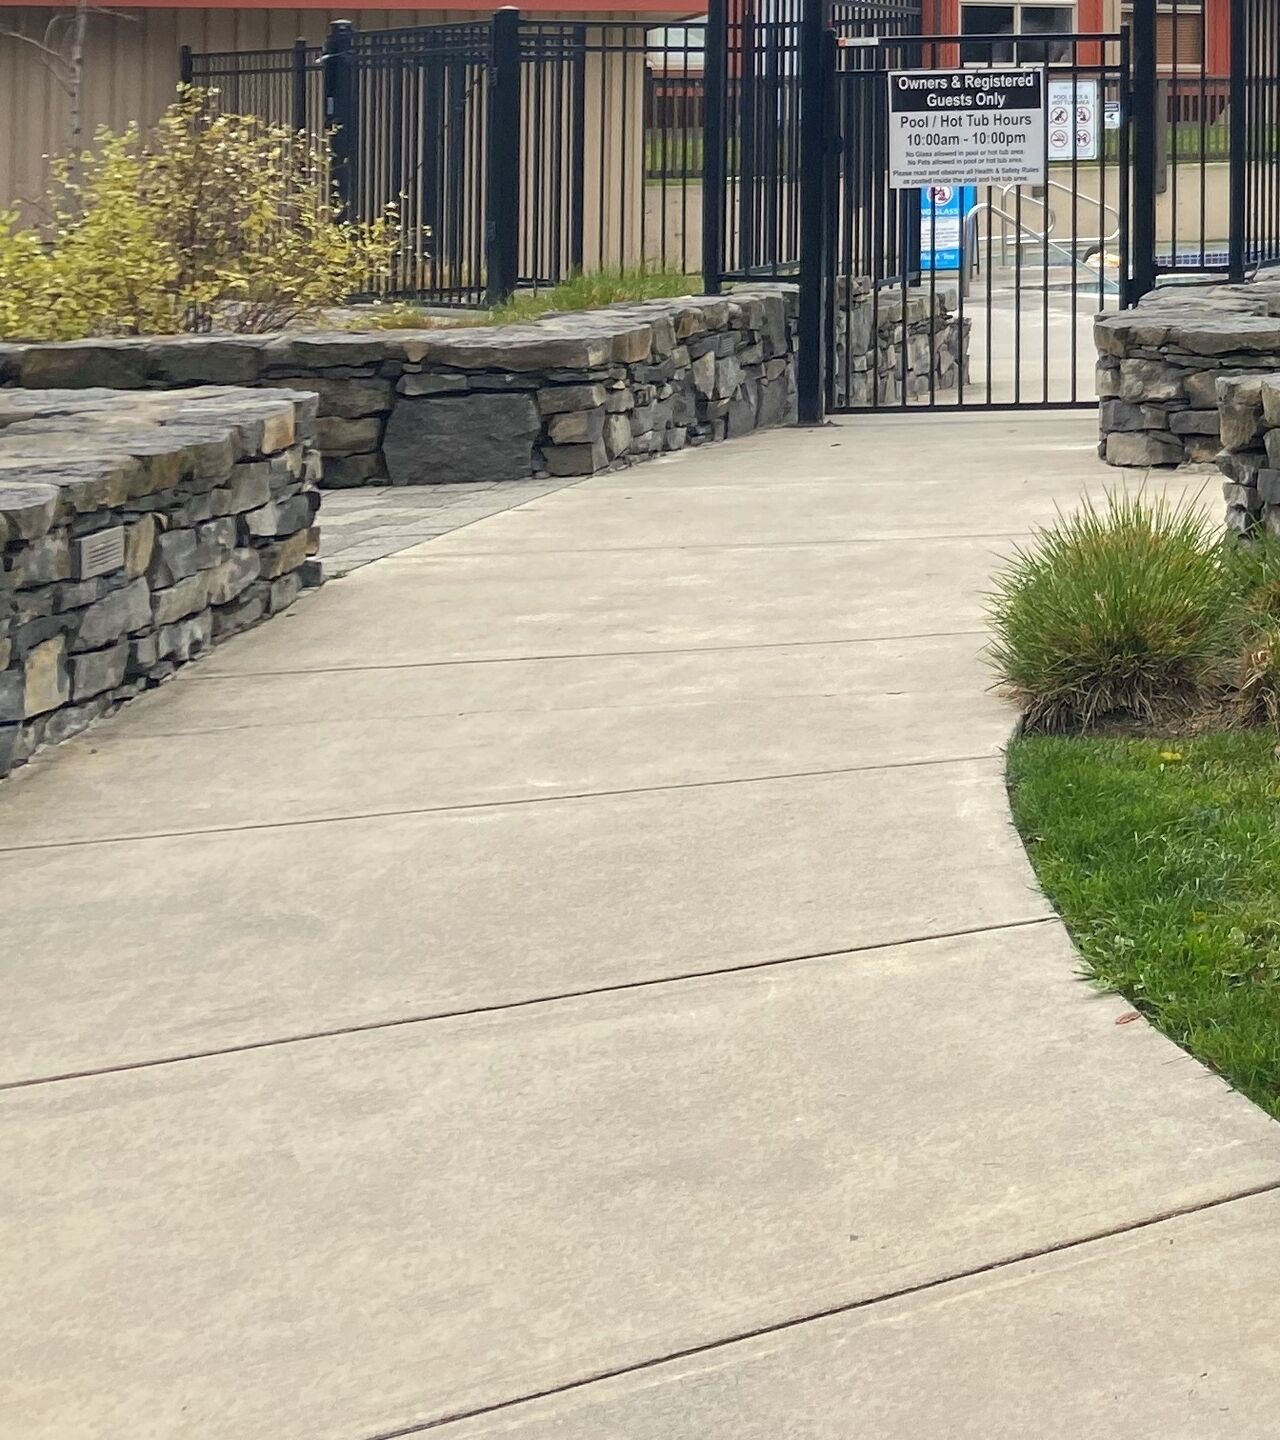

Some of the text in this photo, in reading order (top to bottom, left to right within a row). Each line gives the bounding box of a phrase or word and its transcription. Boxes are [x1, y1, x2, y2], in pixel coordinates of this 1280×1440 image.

[898, 74, 1034, 90] Owners & Registered
[926, 92, 1006, 108] Guests Only
[900, 113, 1032, 128] Pool / Hot Tub Hours
[907, 133, 960, 146] 10:00am
[972, 131, 1026, 146] 10:00pm
[965, 150, 979, 158] pool
[963, 158, 977, 166] pool
[1001, 167, 1020, 175] Safety
